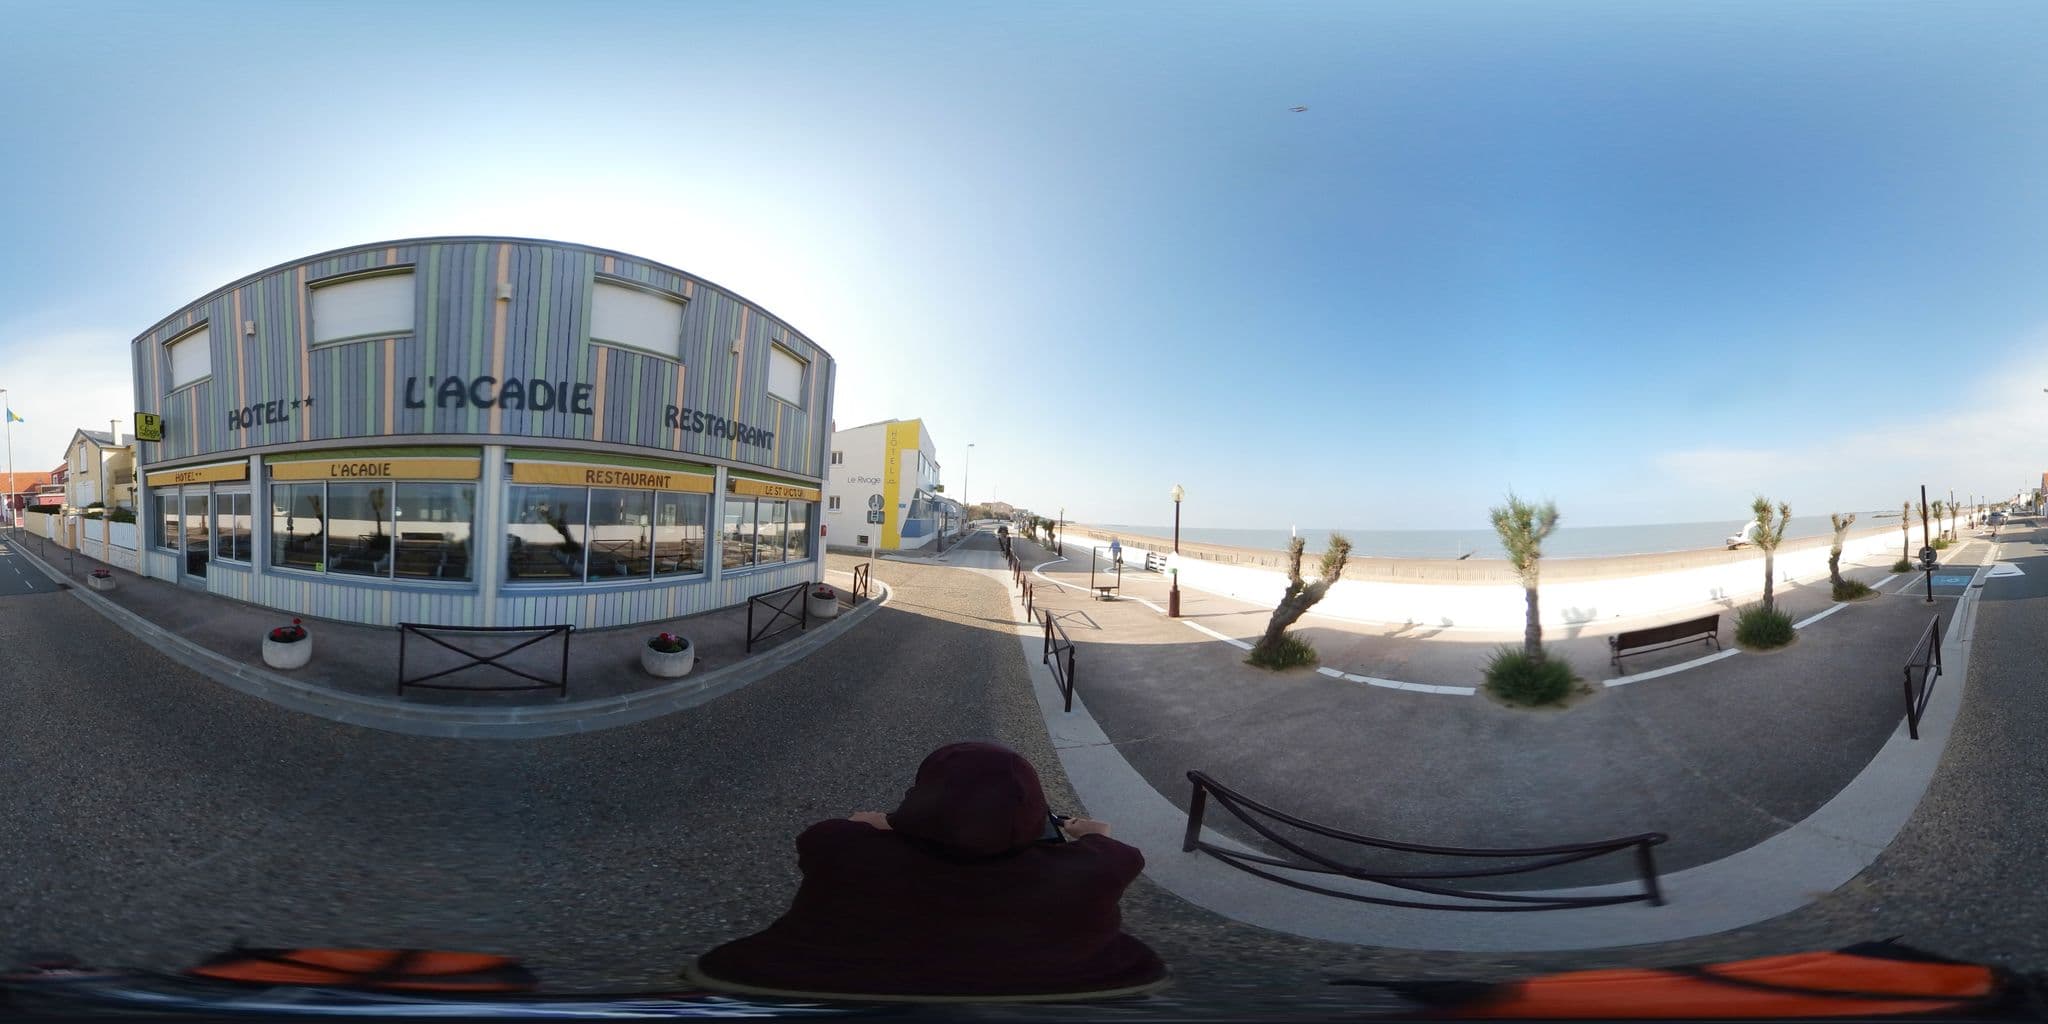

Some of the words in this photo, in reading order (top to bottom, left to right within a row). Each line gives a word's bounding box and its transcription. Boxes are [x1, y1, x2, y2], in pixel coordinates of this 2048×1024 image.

[405, 376, 593, 415] L'ACADIE
[228, 399, 289, 431] HOTEL
[665, 404, 774, 450] RESTAURANT
[331, 463, 391, 476] L'ACADIE
[586, 469, 671, 488] RESTAURANT
[765, 485, 773, 495] LE
[774, 486, 782, 496] ST
